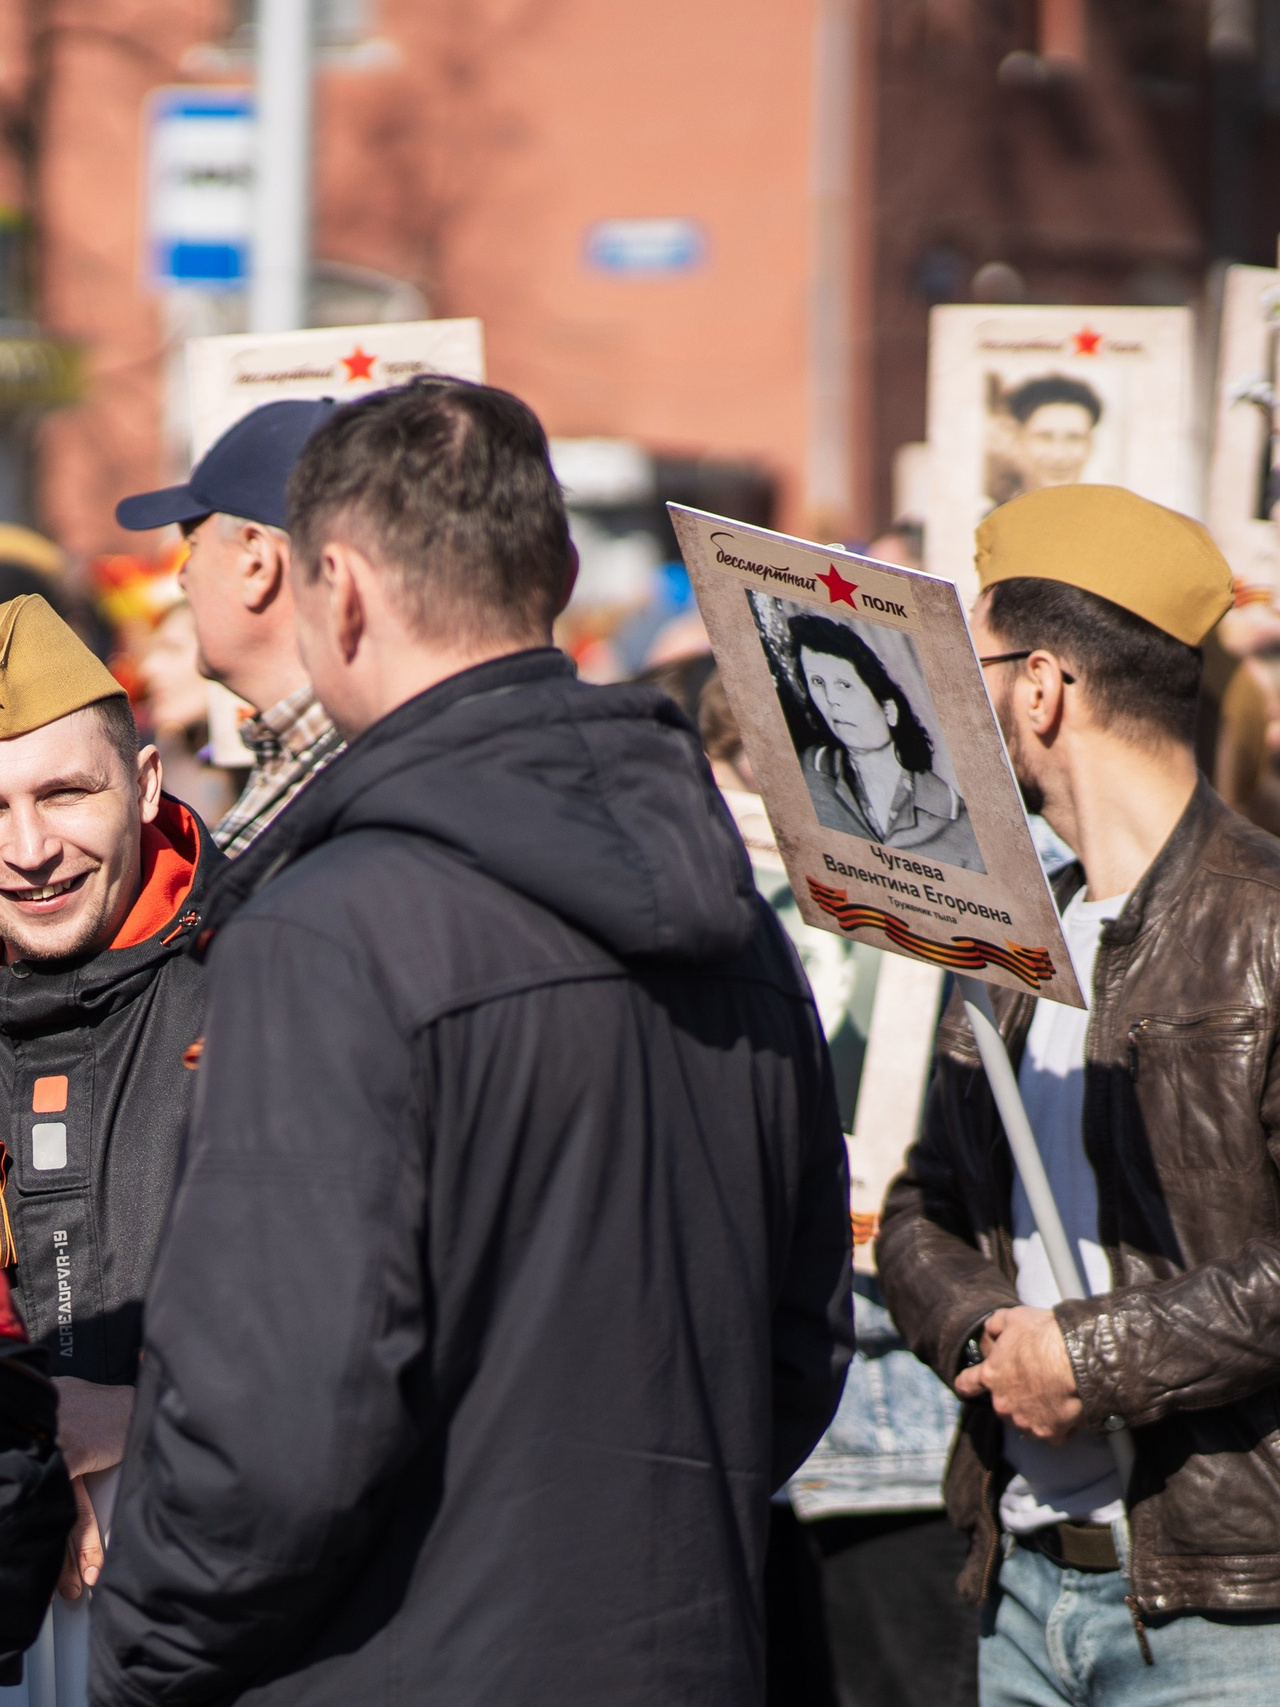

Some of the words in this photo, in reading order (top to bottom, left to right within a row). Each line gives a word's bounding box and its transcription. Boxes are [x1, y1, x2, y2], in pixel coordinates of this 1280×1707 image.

[710, 532, 817, 592] бессмертный
[861, 594, 908, 618] полк
[823, 853, 920, 898] Валентина
[923, 884, 1012, 925] Егоровна
[870, 845, 945, 882] Чугаева
[887, 895, 932, 918] Труженик
[933, 910, 958, 925] тыла
